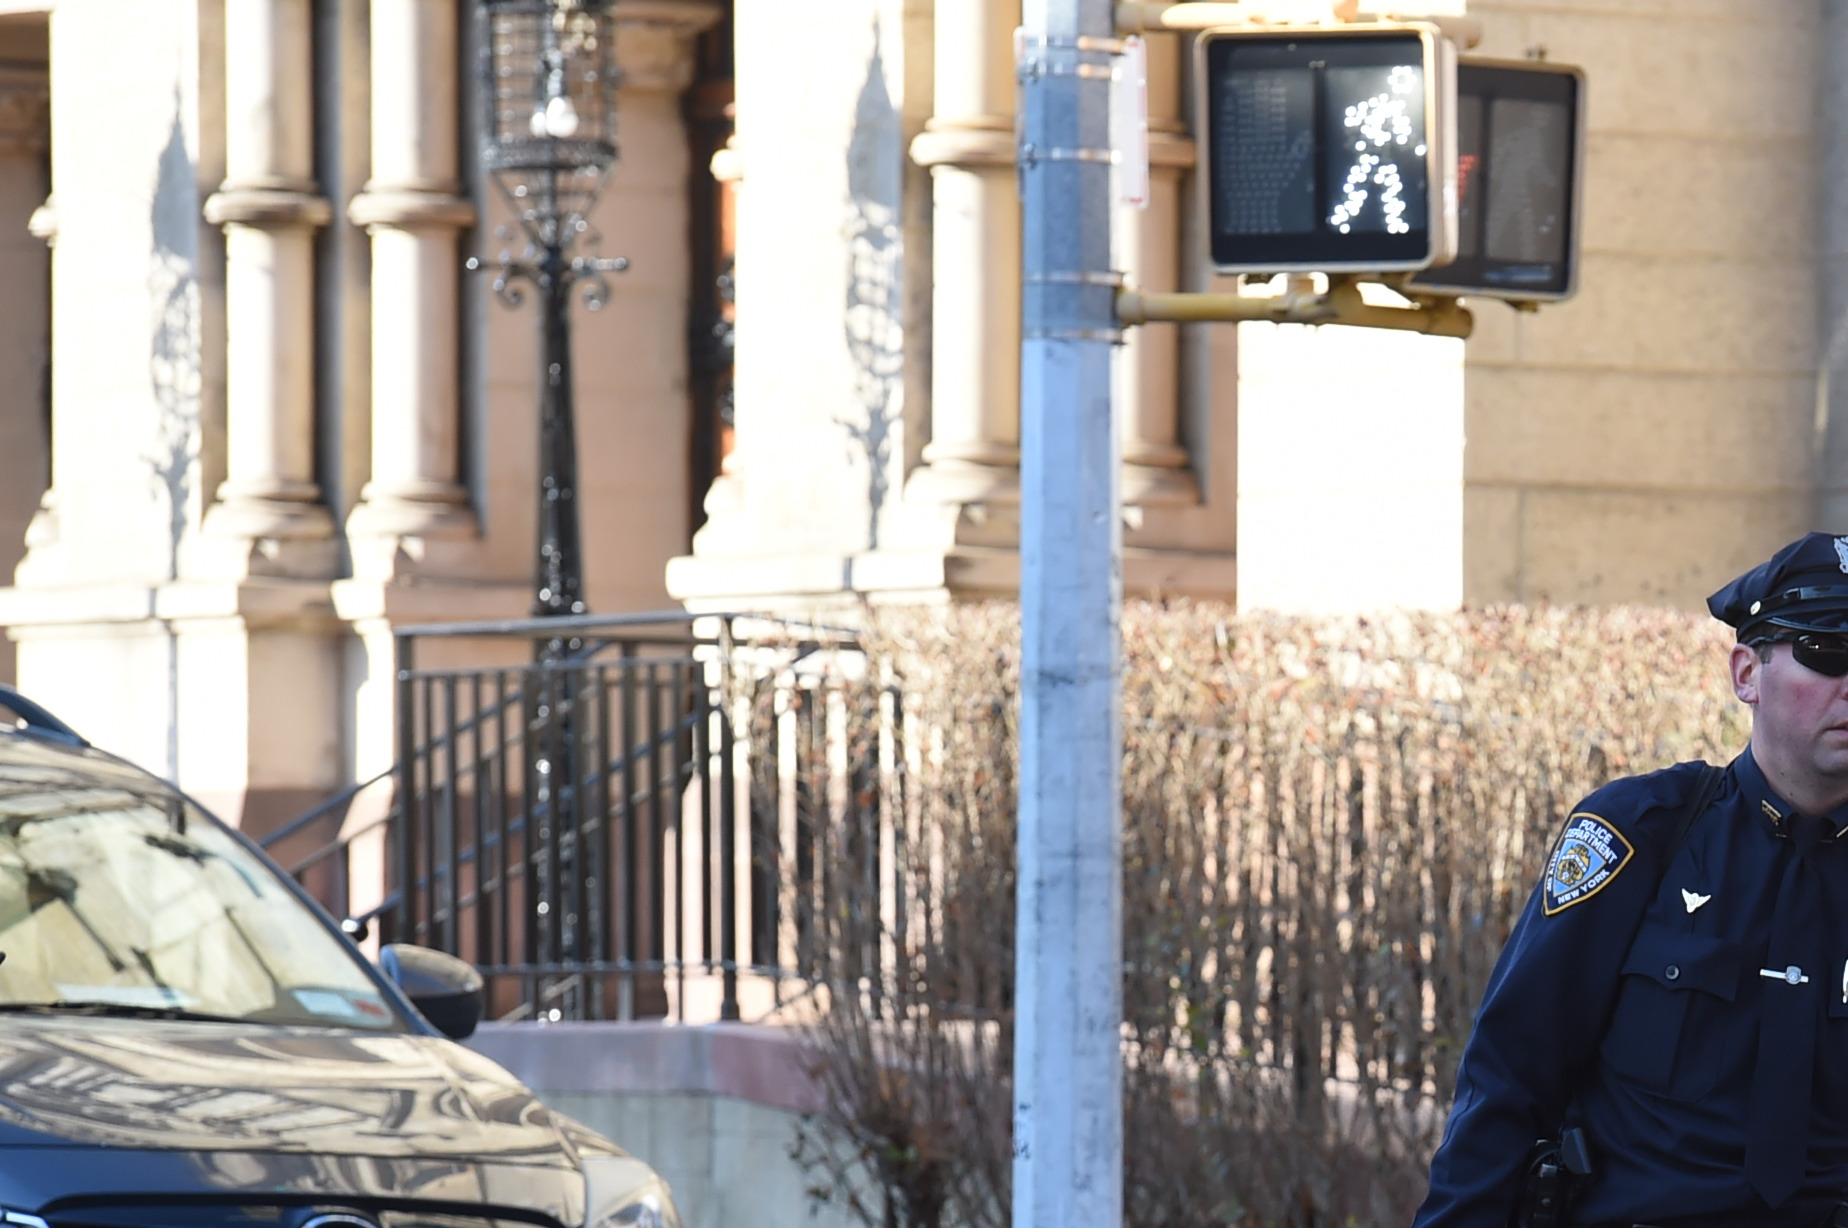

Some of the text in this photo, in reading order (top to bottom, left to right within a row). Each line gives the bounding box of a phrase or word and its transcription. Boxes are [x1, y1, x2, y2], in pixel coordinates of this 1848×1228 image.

[1564, 828, 1618, 864] DEPARTMENT
[1579, 819, 1613, 843] POLICE
[1557, 887, 1580, 905] NEW
[1580, 868, 1610, 893] YORK
